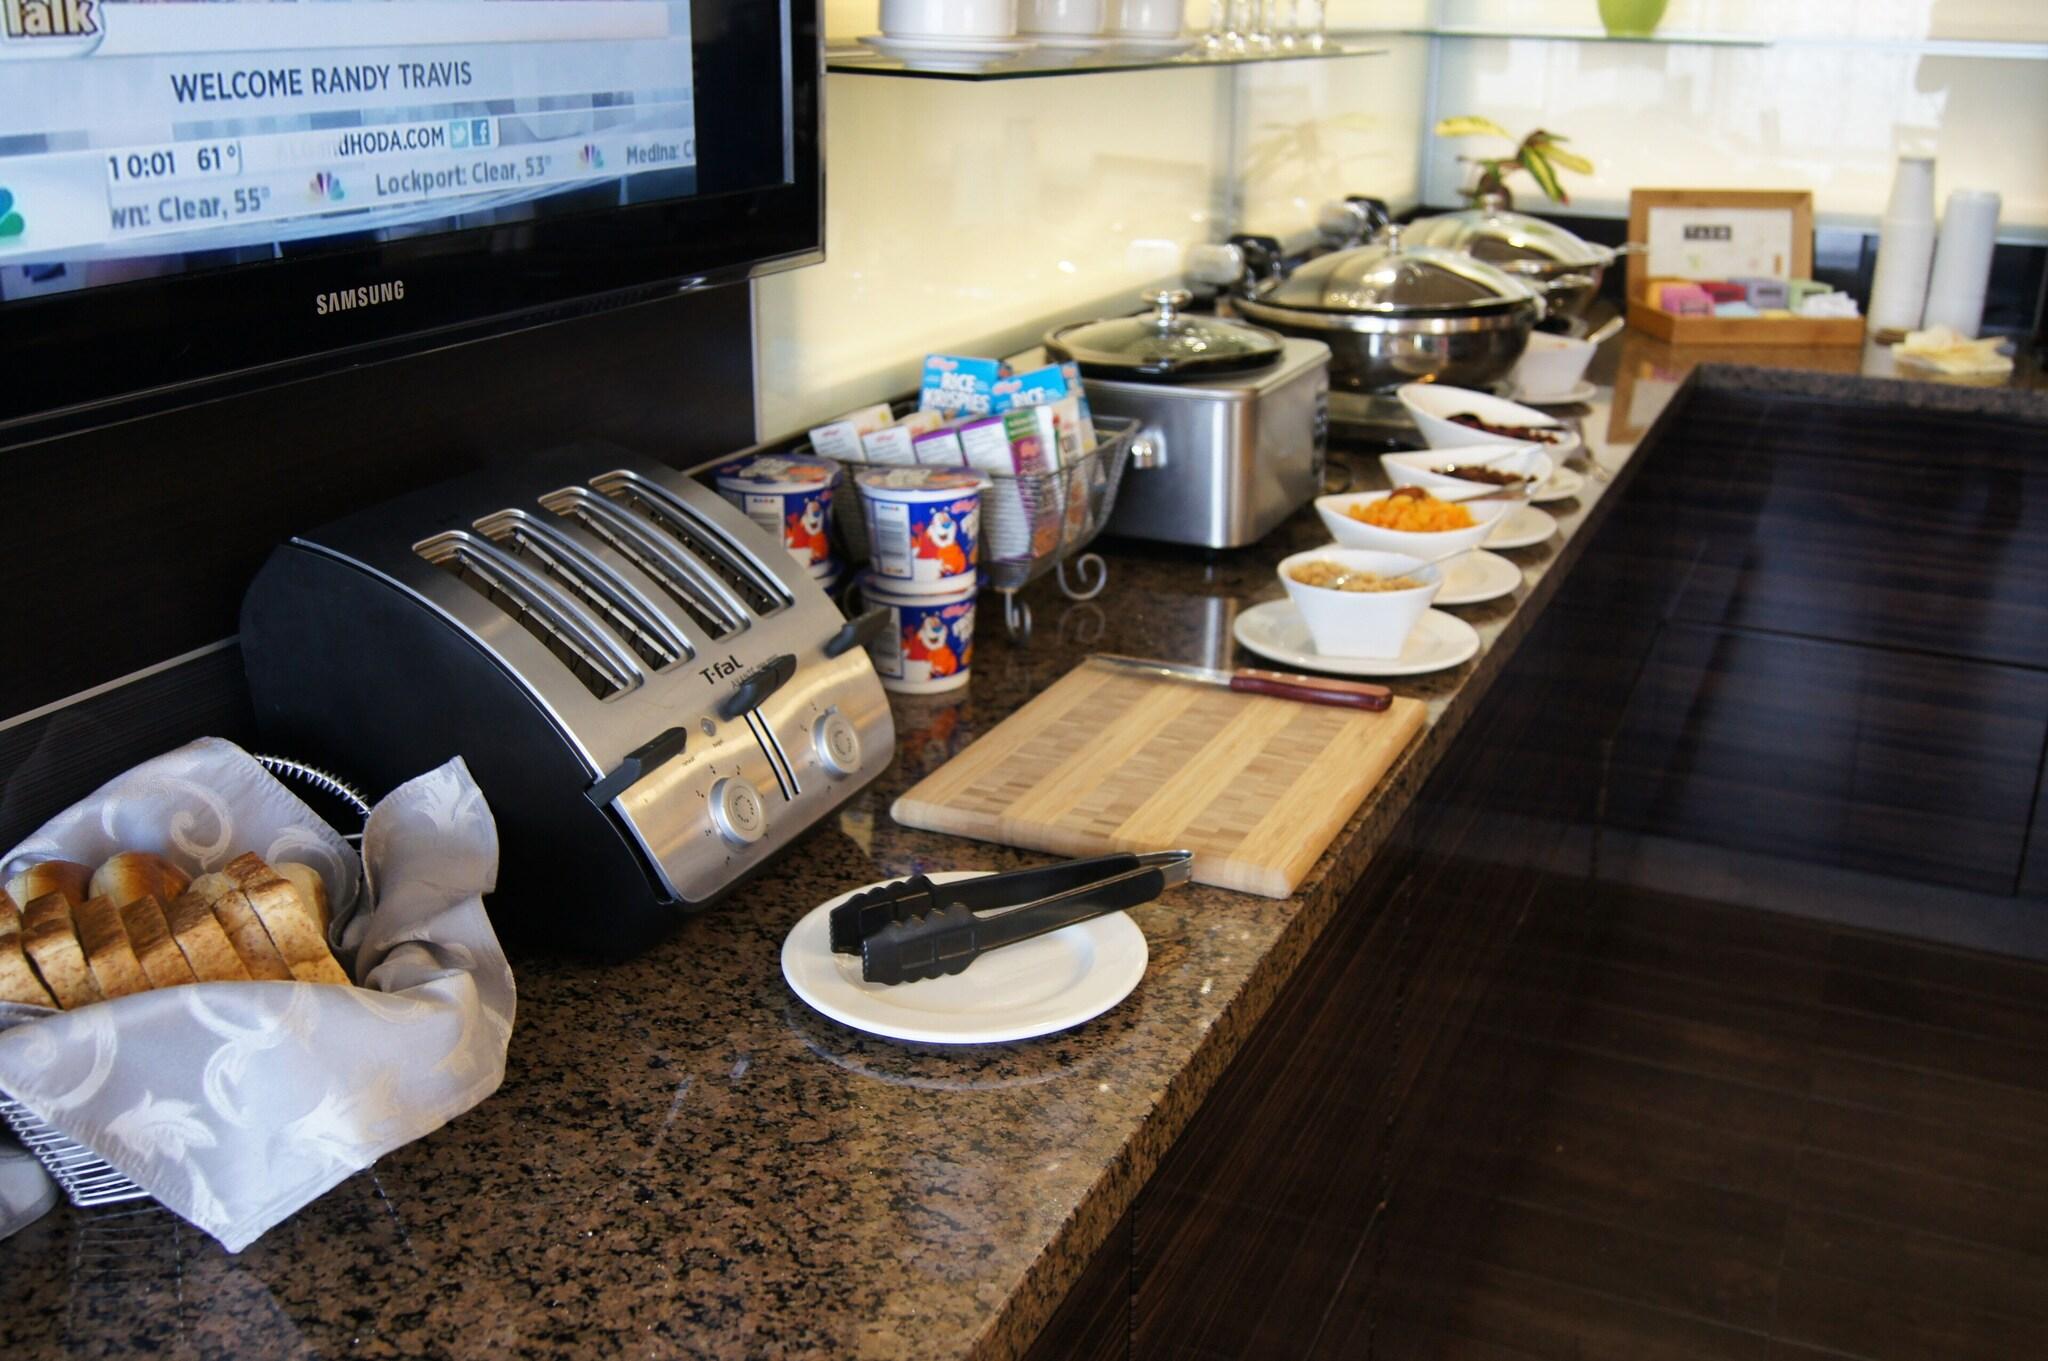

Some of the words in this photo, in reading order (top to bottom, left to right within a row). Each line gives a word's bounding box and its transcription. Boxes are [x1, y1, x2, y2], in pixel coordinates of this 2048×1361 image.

[171, 68, 303, 103] WELCOME
[312, 64, 390, 94] RANDY
[398, 61, 473, 89] TRAVIS
[109, 151, 175, 180] 10:01
[376, 164, 467, 199] Lockport:
[472, 160, 522, 184] Clear,
[158, 196, 228, 222] Clear,
[316, 280, 405, 315] SAMSUNG
